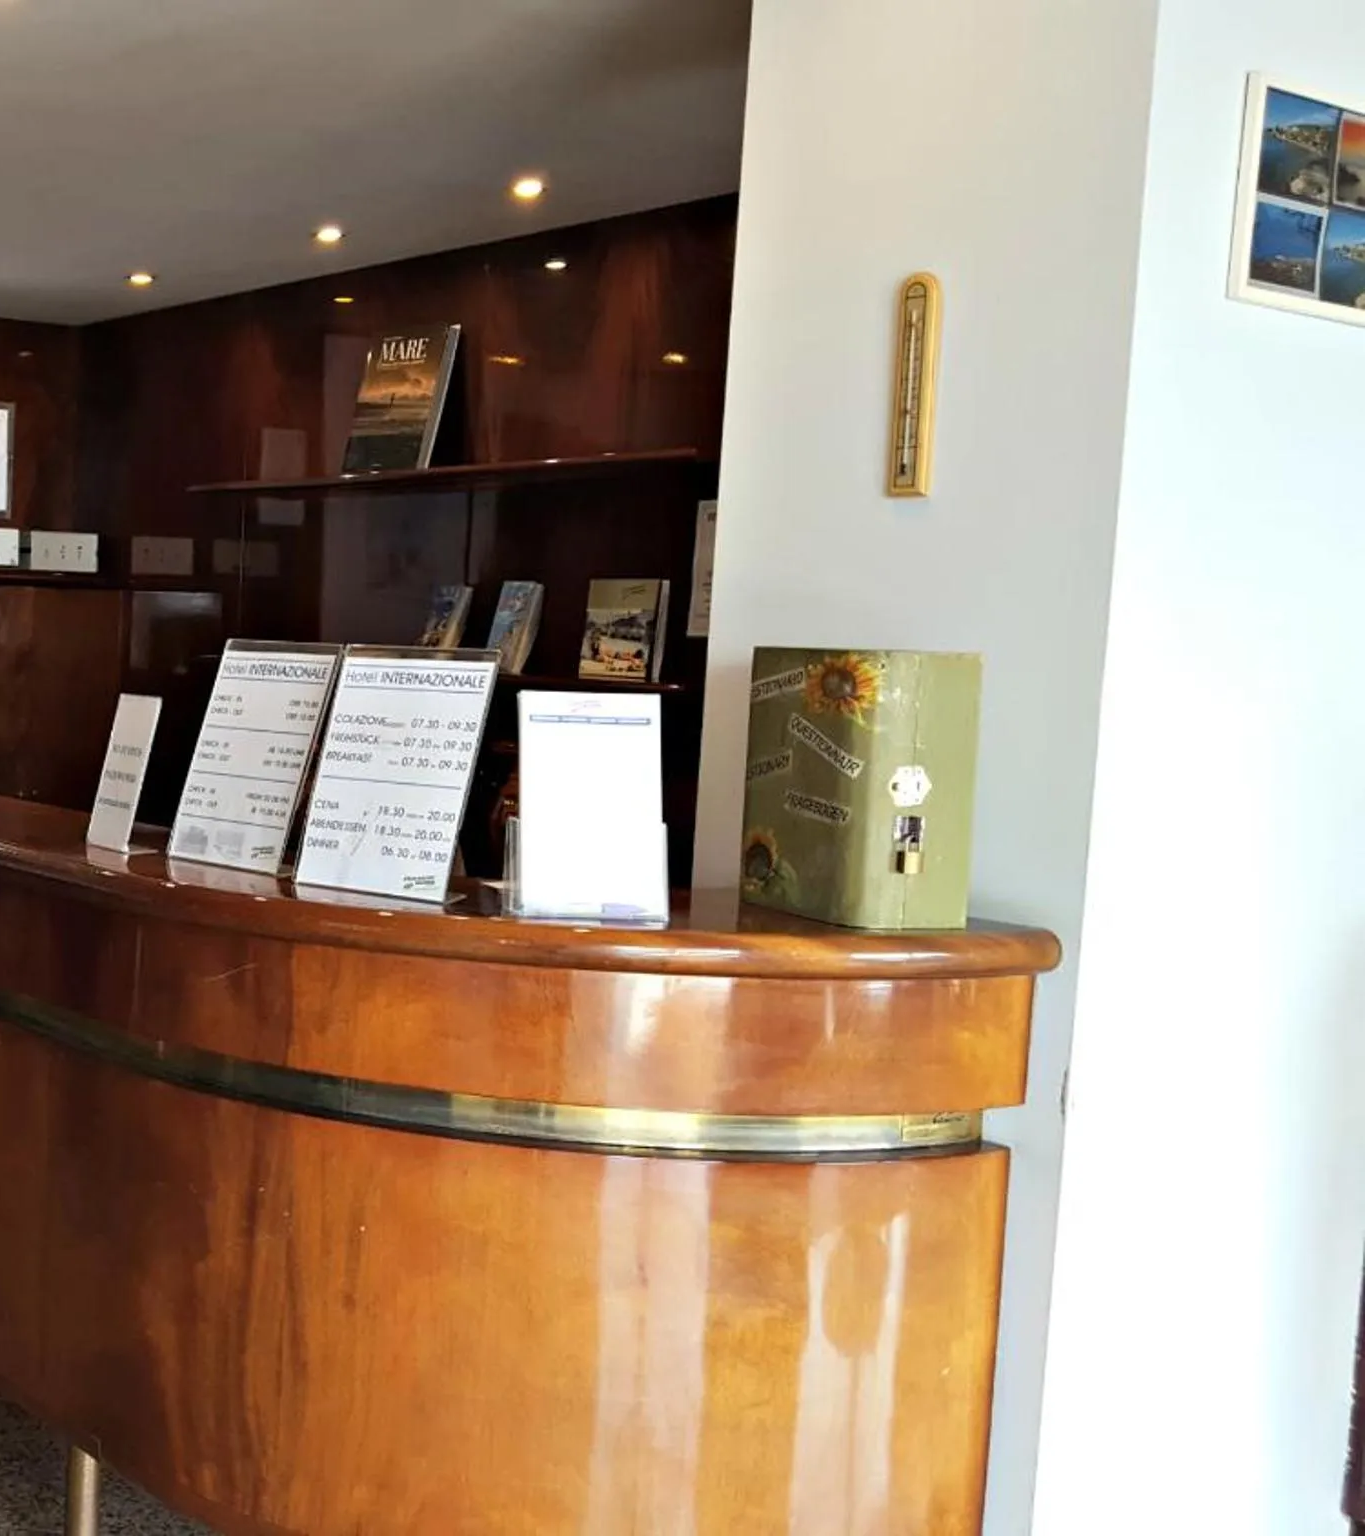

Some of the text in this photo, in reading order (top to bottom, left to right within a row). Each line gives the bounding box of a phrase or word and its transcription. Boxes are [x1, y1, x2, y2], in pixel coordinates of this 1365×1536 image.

[381, 337, 429, 361] MARE
[248, 664, 328, 680] INTERNAZIONALE
[345, 670, 487, 689] Hotel INTERNAZIONALE
[314, 799, 340, 810] CENA
